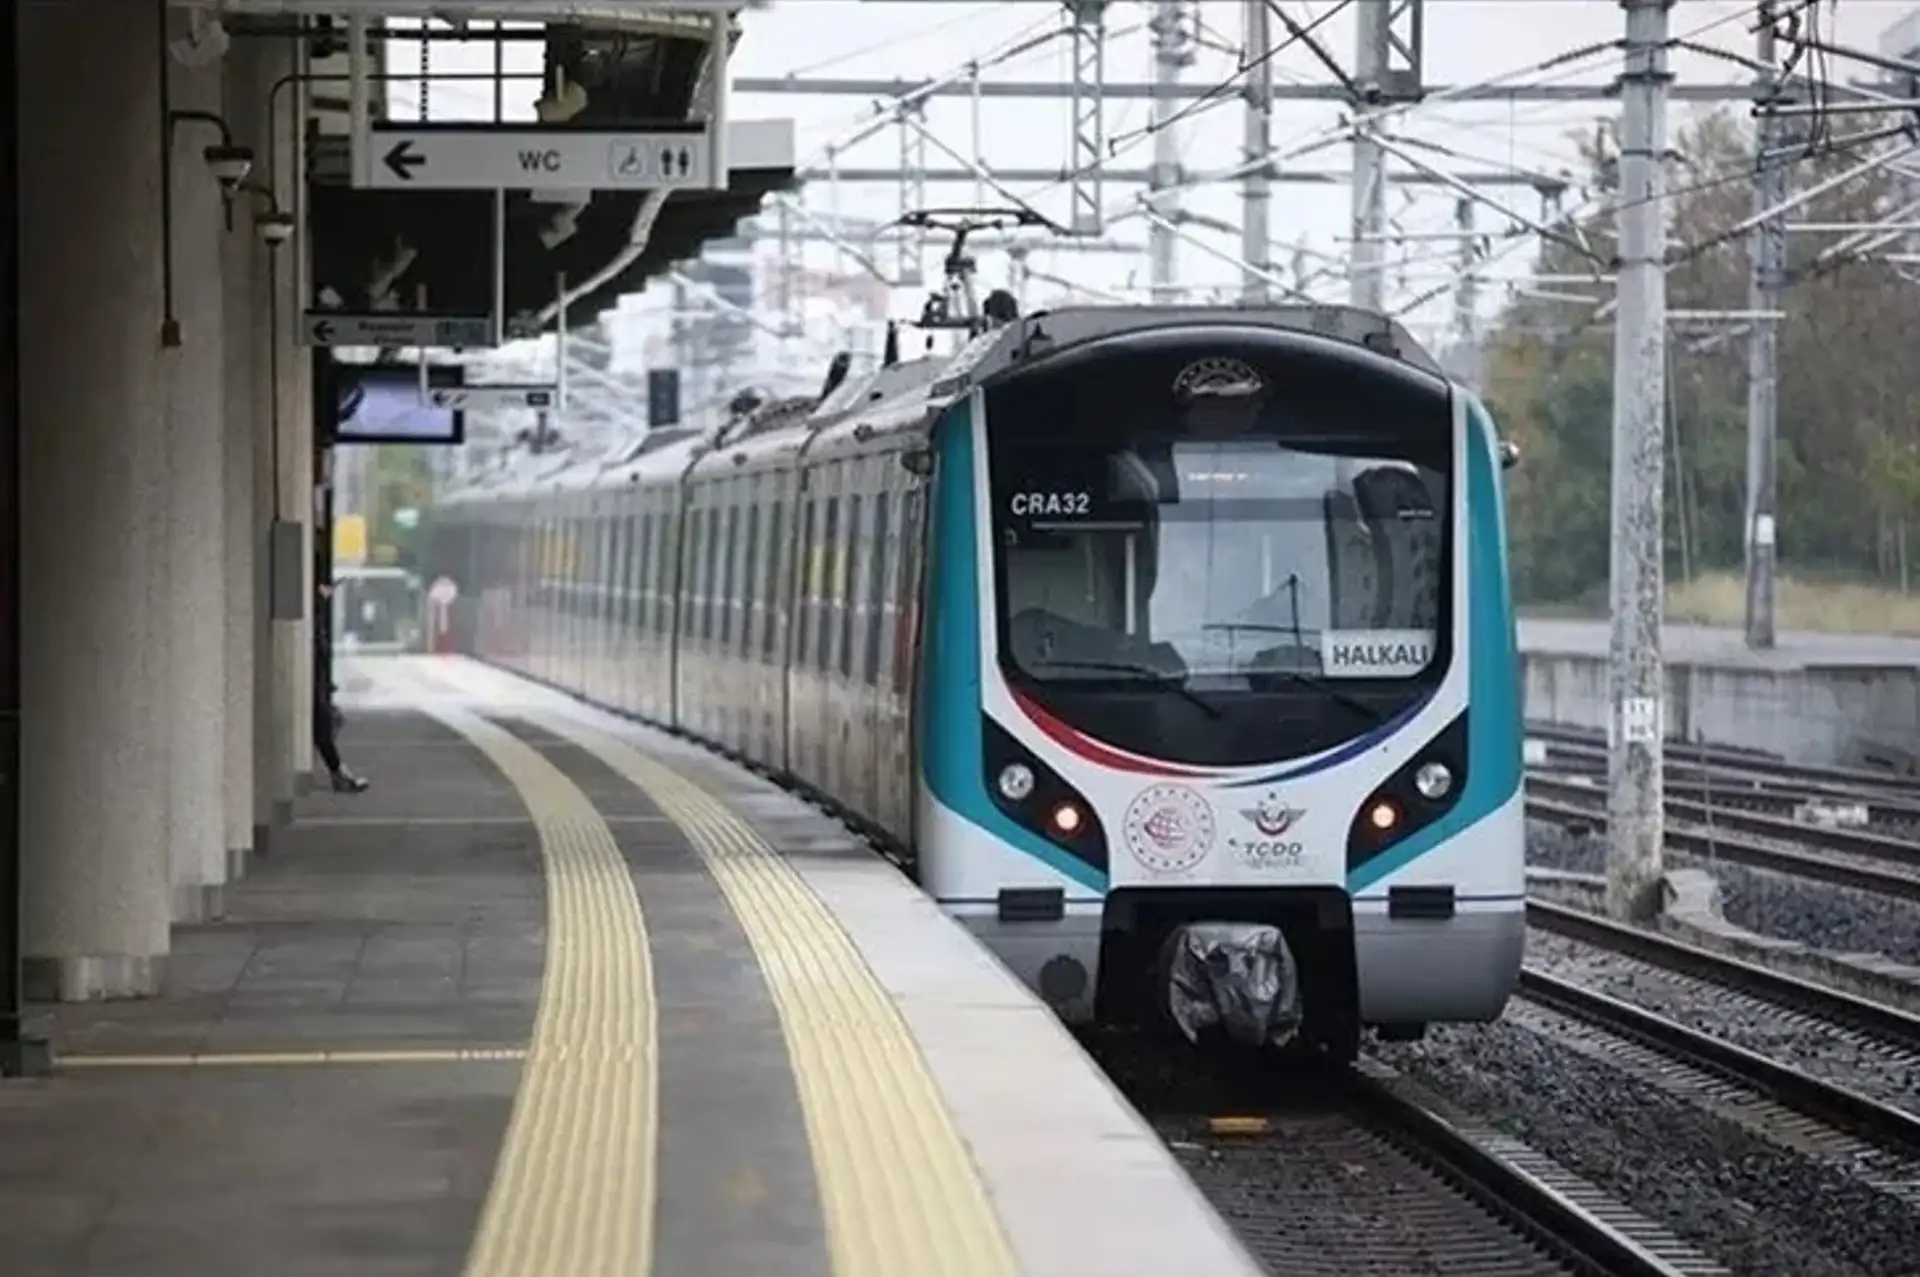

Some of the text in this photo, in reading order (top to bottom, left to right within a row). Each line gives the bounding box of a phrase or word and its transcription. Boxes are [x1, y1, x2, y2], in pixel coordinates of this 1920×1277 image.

[518, 149, 562, 172] WC
[1011, 492, 1090, 515] CRA32
[1332, 644, 1429, 666] HALKALI
